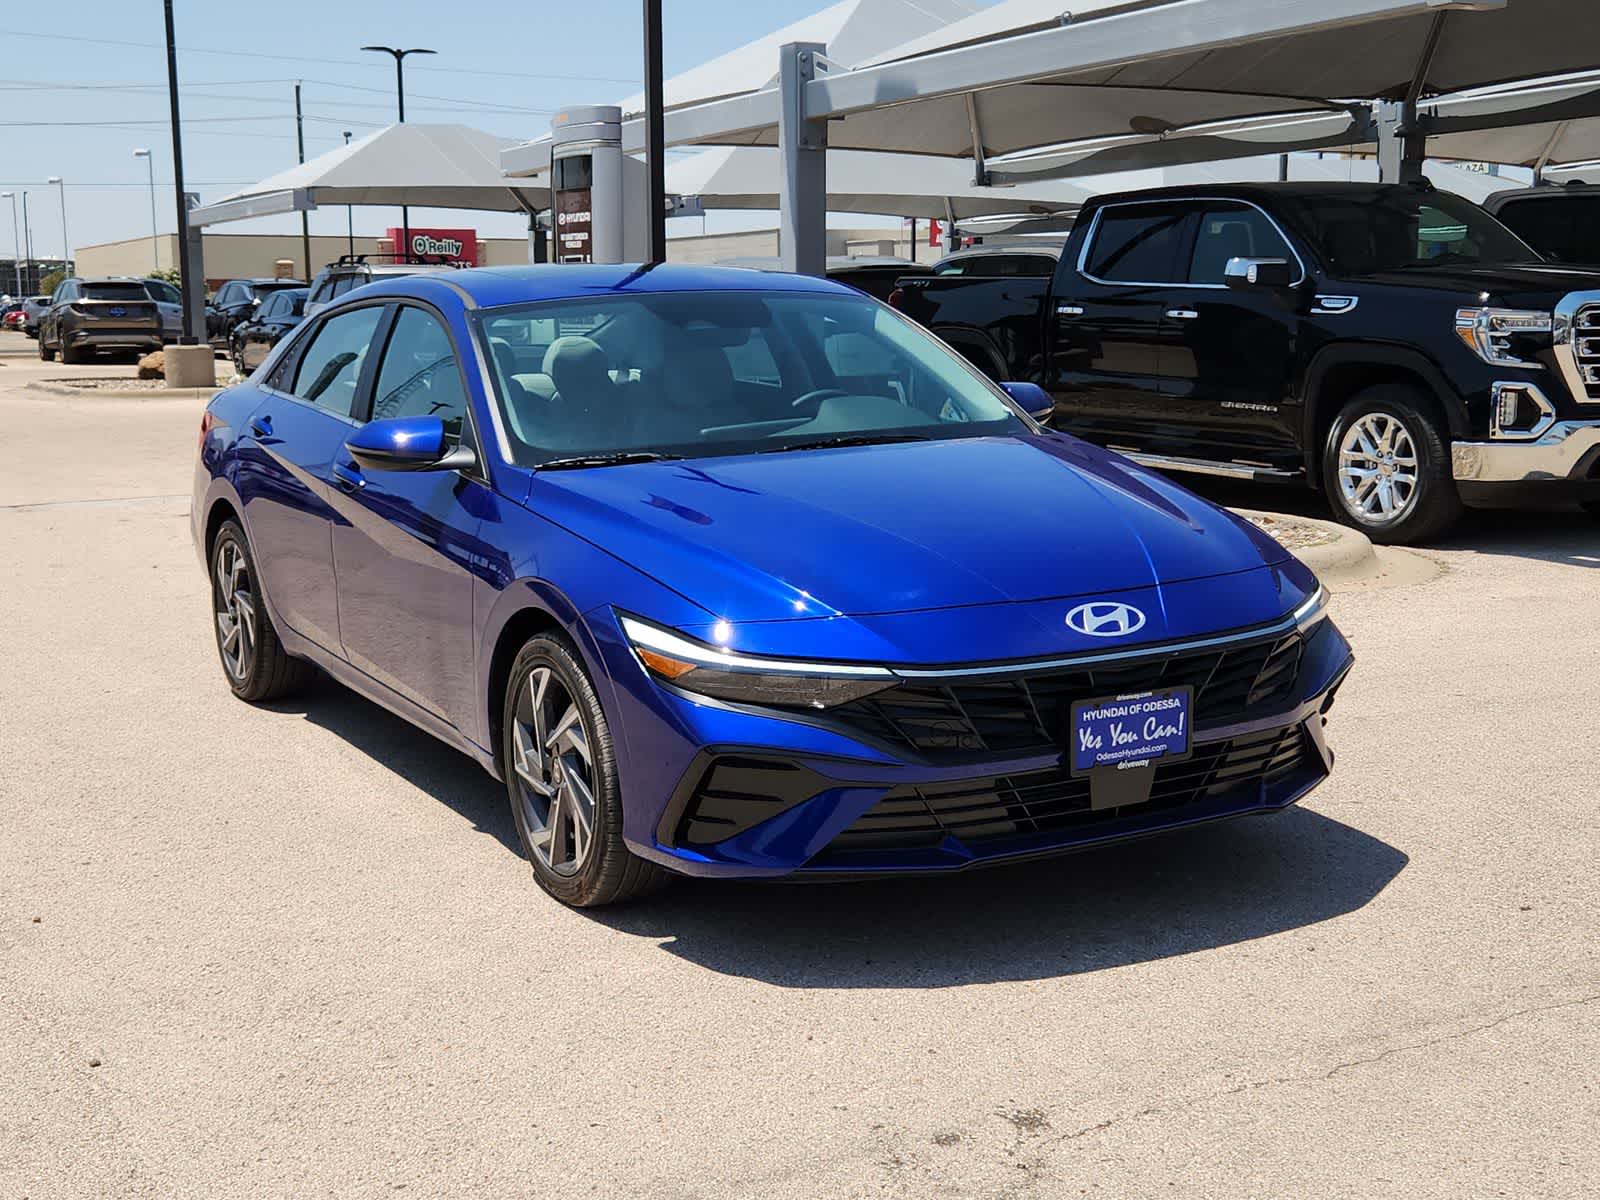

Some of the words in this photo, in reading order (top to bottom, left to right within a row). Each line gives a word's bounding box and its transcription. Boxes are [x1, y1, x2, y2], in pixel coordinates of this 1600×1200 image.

[412, 236, 462, 257] O'Reilly
[1220, 401, 1278, 412] SIERRA
[1083, 706, 1128, 721] HYUNDAI
[1129, 703, 1142, 715] OF
[1142, 698, 1181, 713] ODESSA
[1079, 726, 1103, 752] Yes
[1109, 721, 1139, 747] You
[1143, 711, 1185, 741] Can!
[1096, 743, 1168, 761] OdessaHyundai.com
[1117, 759, 1150, 770] driveway
